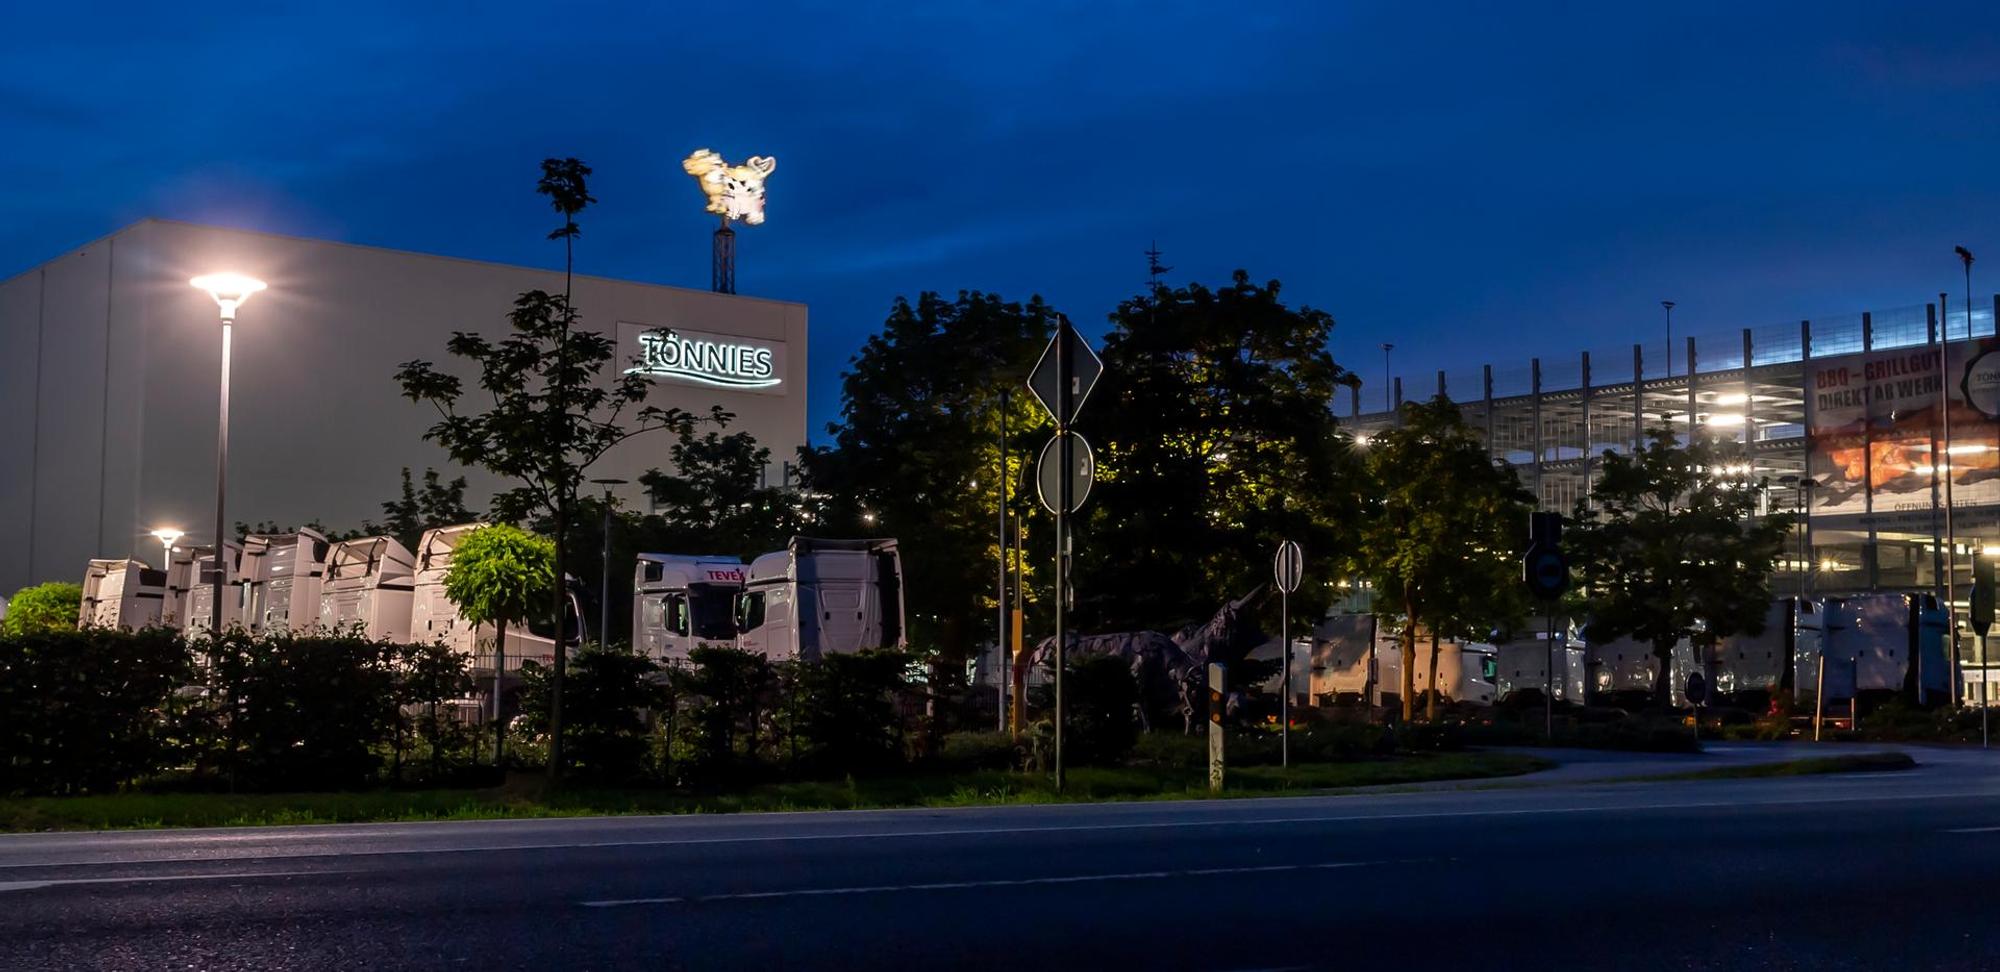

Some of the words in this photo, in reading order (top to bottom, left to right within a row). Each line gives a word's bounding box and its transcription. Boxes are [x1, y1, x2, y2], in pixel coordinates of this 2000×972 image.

[639, 334, 772, 377] TÖNNIES
[1816, 367, 1848, 389] BBQ
[1864, 351, 1943, 380] GRILLGUT
[1818, 386, 1871, 411] DIREKT
[1875, 383, 1894, 401] AB
[1897, 374, 1943, 398] WERK
